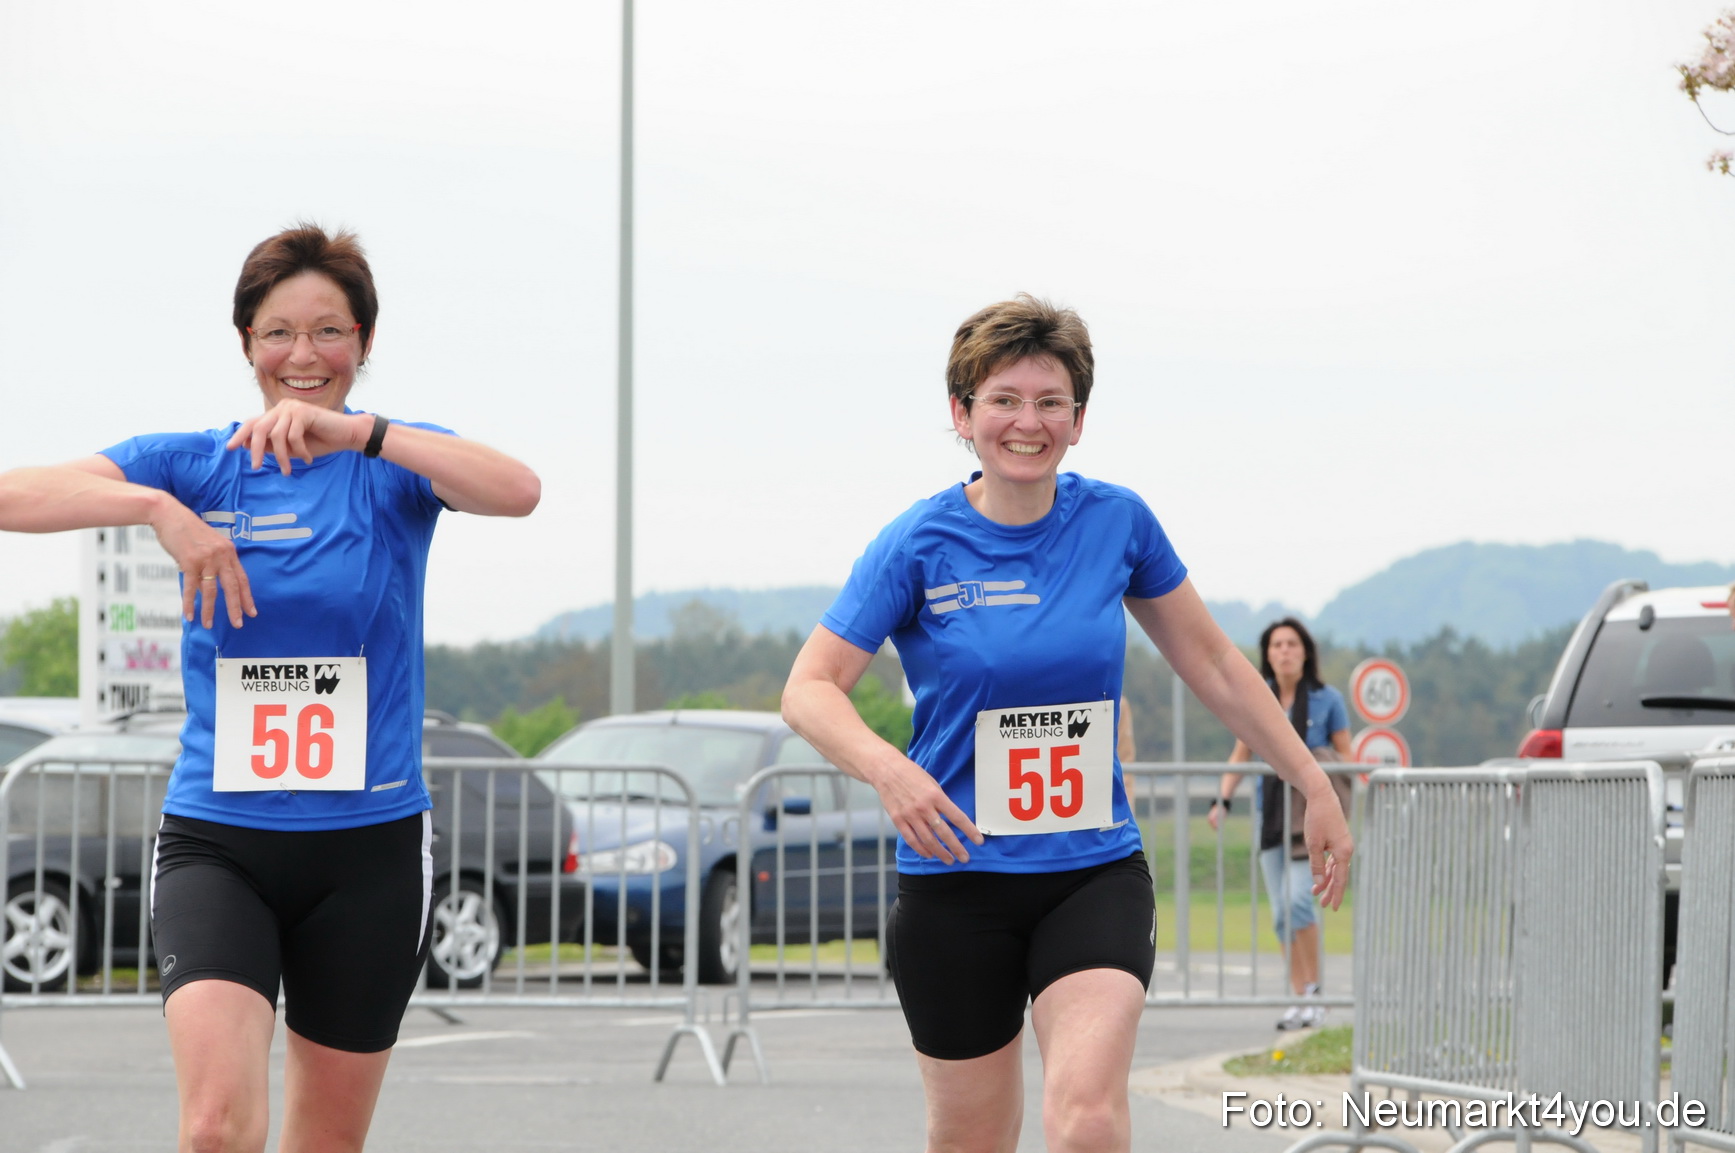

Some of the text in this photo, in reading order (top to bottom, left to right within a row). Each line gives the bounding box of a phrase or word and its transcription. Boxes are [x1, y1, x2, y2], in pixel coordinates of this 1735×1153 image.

[241, 664, 310, 680] MEYER
[241, 680, 310, 692] WERBUNG
[1366, 677, 1396, 707] 60
[999, 711, 1063, 728] MEYER
[250, 702, 335, 780] 56
[999, 726, 1064, 740] WERBUNG
[1008, 743, 1084, 822] 55
